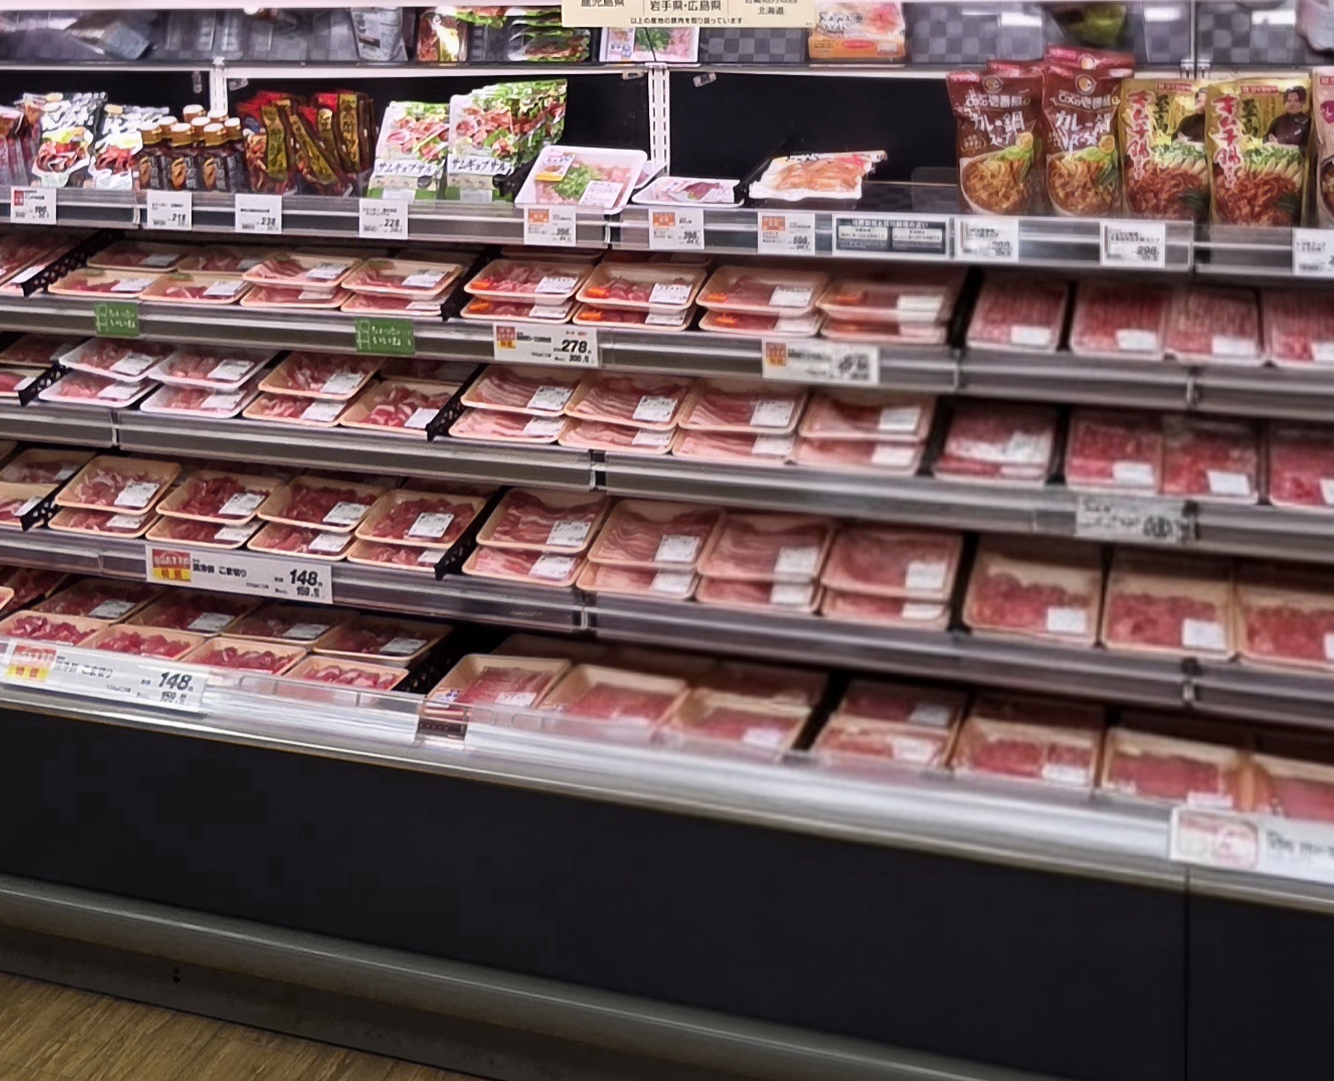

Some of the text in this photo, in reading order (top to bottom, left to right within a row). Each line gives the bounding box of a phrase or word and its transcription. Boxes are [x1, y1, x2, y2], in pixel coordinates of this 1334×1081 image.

[650, 0, 722, 12] 岩手県・広島県
[758, 6, 784, 16] 北海道
[561, 339, 589, 354] 278
[289, 569, 319, 586] 148
[158, 671, 193, 691] 148
